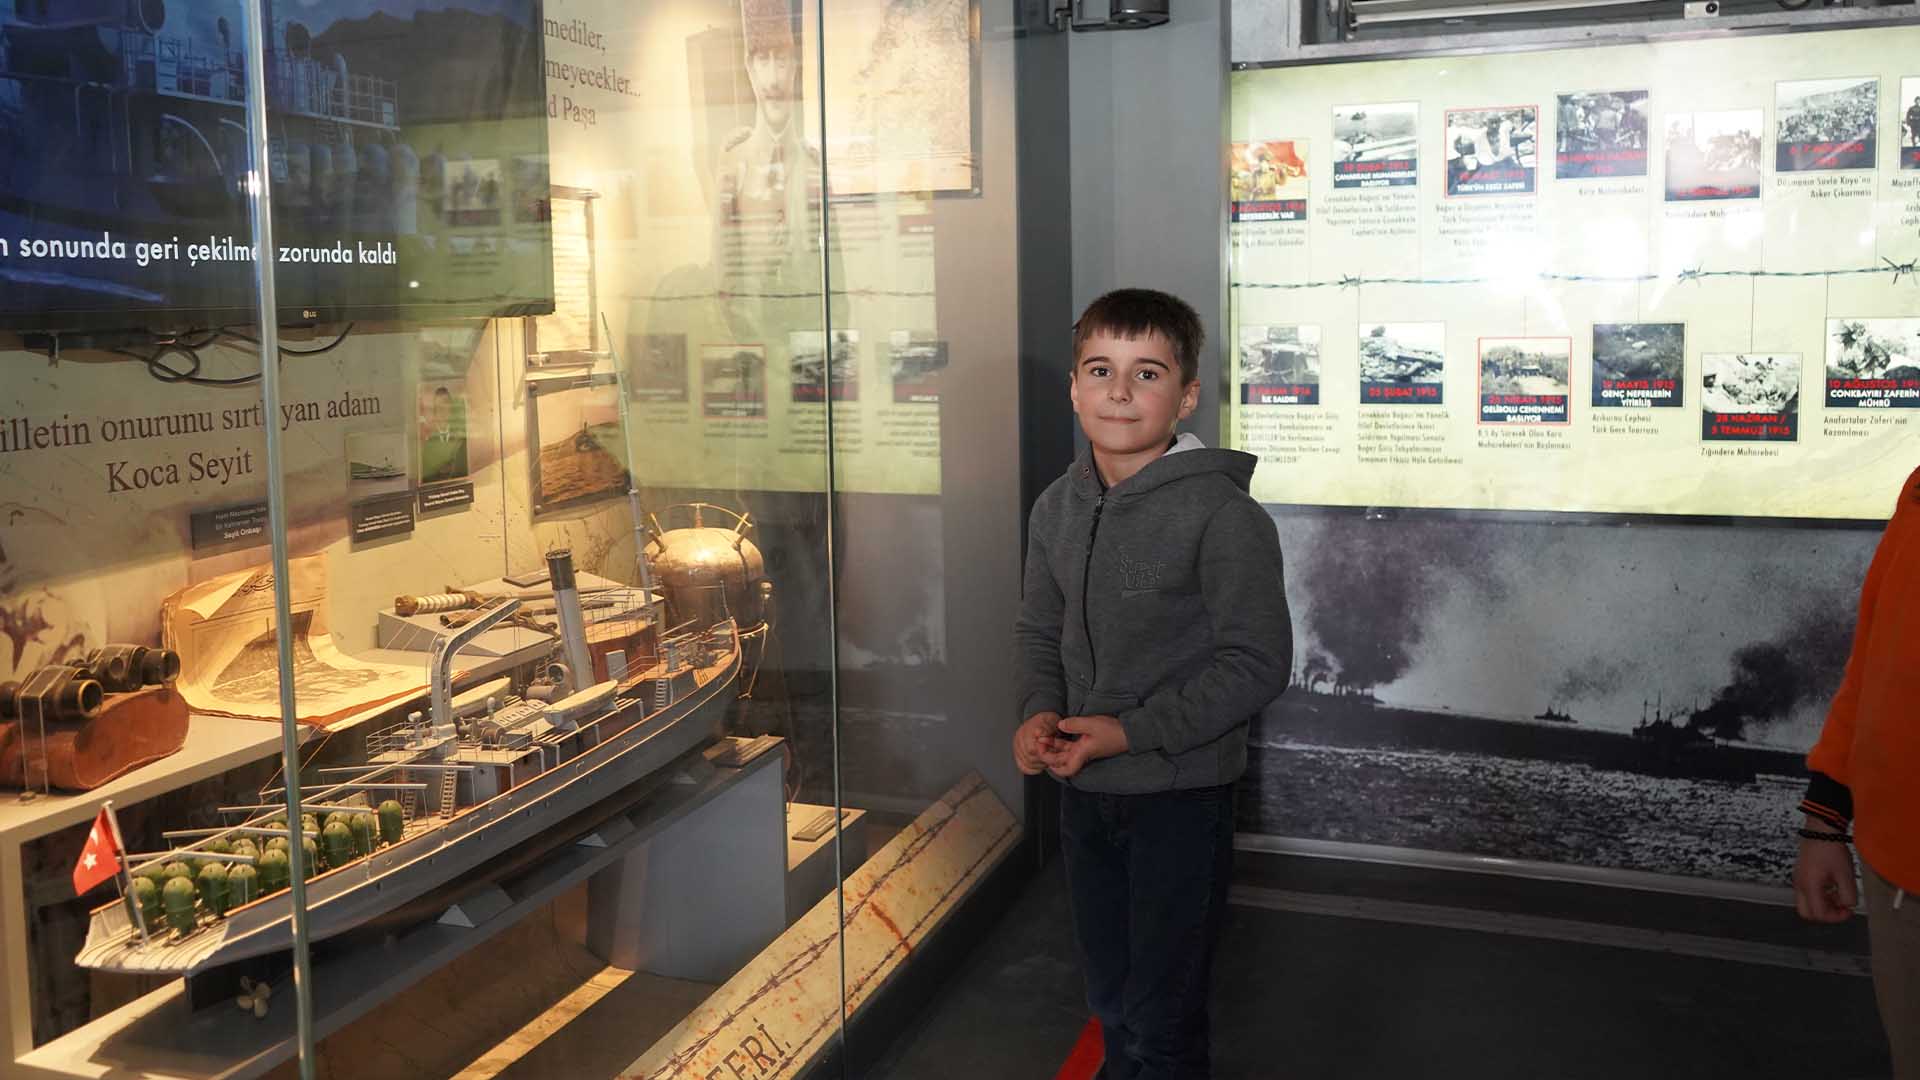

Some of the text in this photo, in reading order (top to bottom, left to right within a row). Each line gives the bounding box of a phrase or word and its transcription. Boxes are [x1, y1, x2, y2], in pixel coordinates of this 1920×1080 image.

[544, 18, 606, 55] mediler,
[545, 59, 641, 97] meyecekler...
[563, 97, 596, 130] Paşa
[20, 232, 126, 260] sonunda
[135, 236, 179, 267] geri
[279, 240, 353, 264] zorunda
[359, 241, 396, 265] kaldı
[1601, 388, 1671, 399] GENÇ NEFERLERİN
[1830, 388, 1919, 398] CONKBAYIRI ZAFERİN
[1859, 398, 1891, 407] MÜHRÜ
[1482, 404, 1564, 414] GELİBOLU CEHENNEMİ
[101, 410, 214, 442] onurunu
[327, 391, 382, 417] adam
[1824, 415, 1867, 425] Anafartalar
[1720, 425, 1763, 435] TEMMUZ
[1824, 428, 1869, 437] Kazanılması
[106, 447, 254, 493] Koca Seyit
